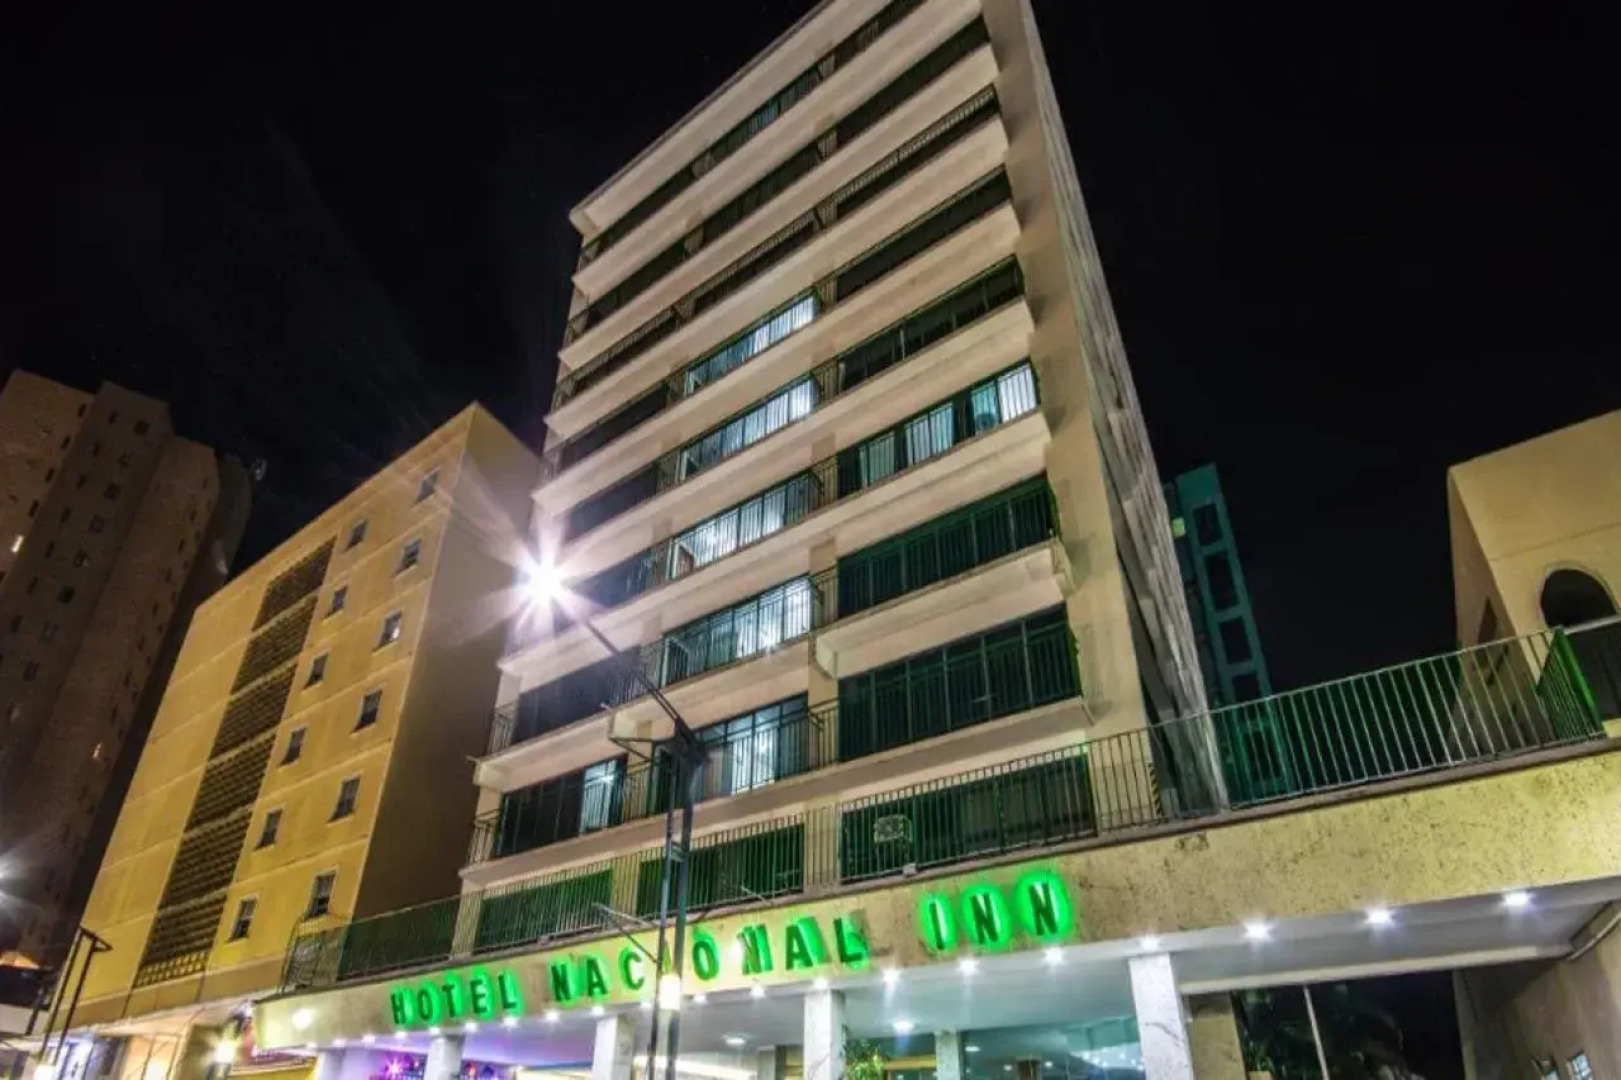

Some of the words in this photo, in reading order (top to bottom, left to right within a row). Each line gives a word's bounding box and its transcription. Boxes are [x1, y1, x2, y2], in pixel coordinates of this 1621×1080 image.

[391, 973, 518, 1025] HOTEL
[551, 917, 866, 1003] NACONAL
[928, 881, 1059, 951] INN
